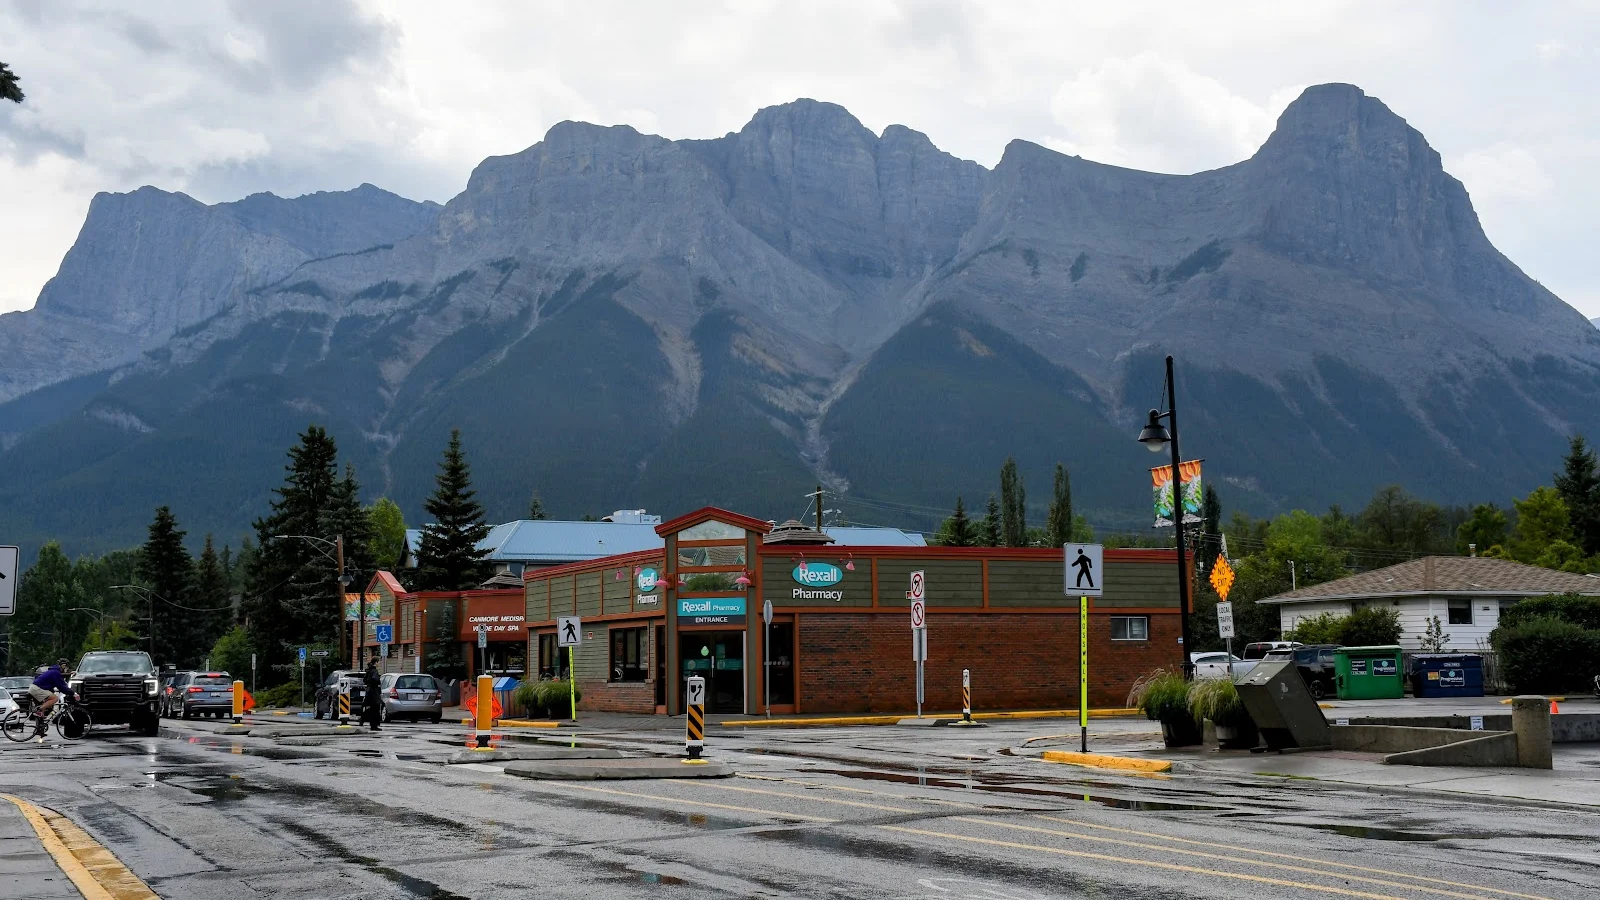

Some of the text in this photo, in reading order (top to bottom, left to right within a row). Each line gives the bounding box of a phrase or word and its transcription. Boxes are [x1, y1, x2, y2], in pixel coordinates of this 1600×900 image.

[799, 568, 837, 583] Rexall
[1217, 567, 1226, 576] NO
[638, 573, 655, 588] Rexall
[1217, 578, 1227, 587] EXIT
[637, 594, 658, 605] Pharmacy
[792, 588, 843, 601] Pharmacy
[682, 601, 741, 612] Rexall Pharmacy
[1219, 606, 1231, 614] LOCAL
